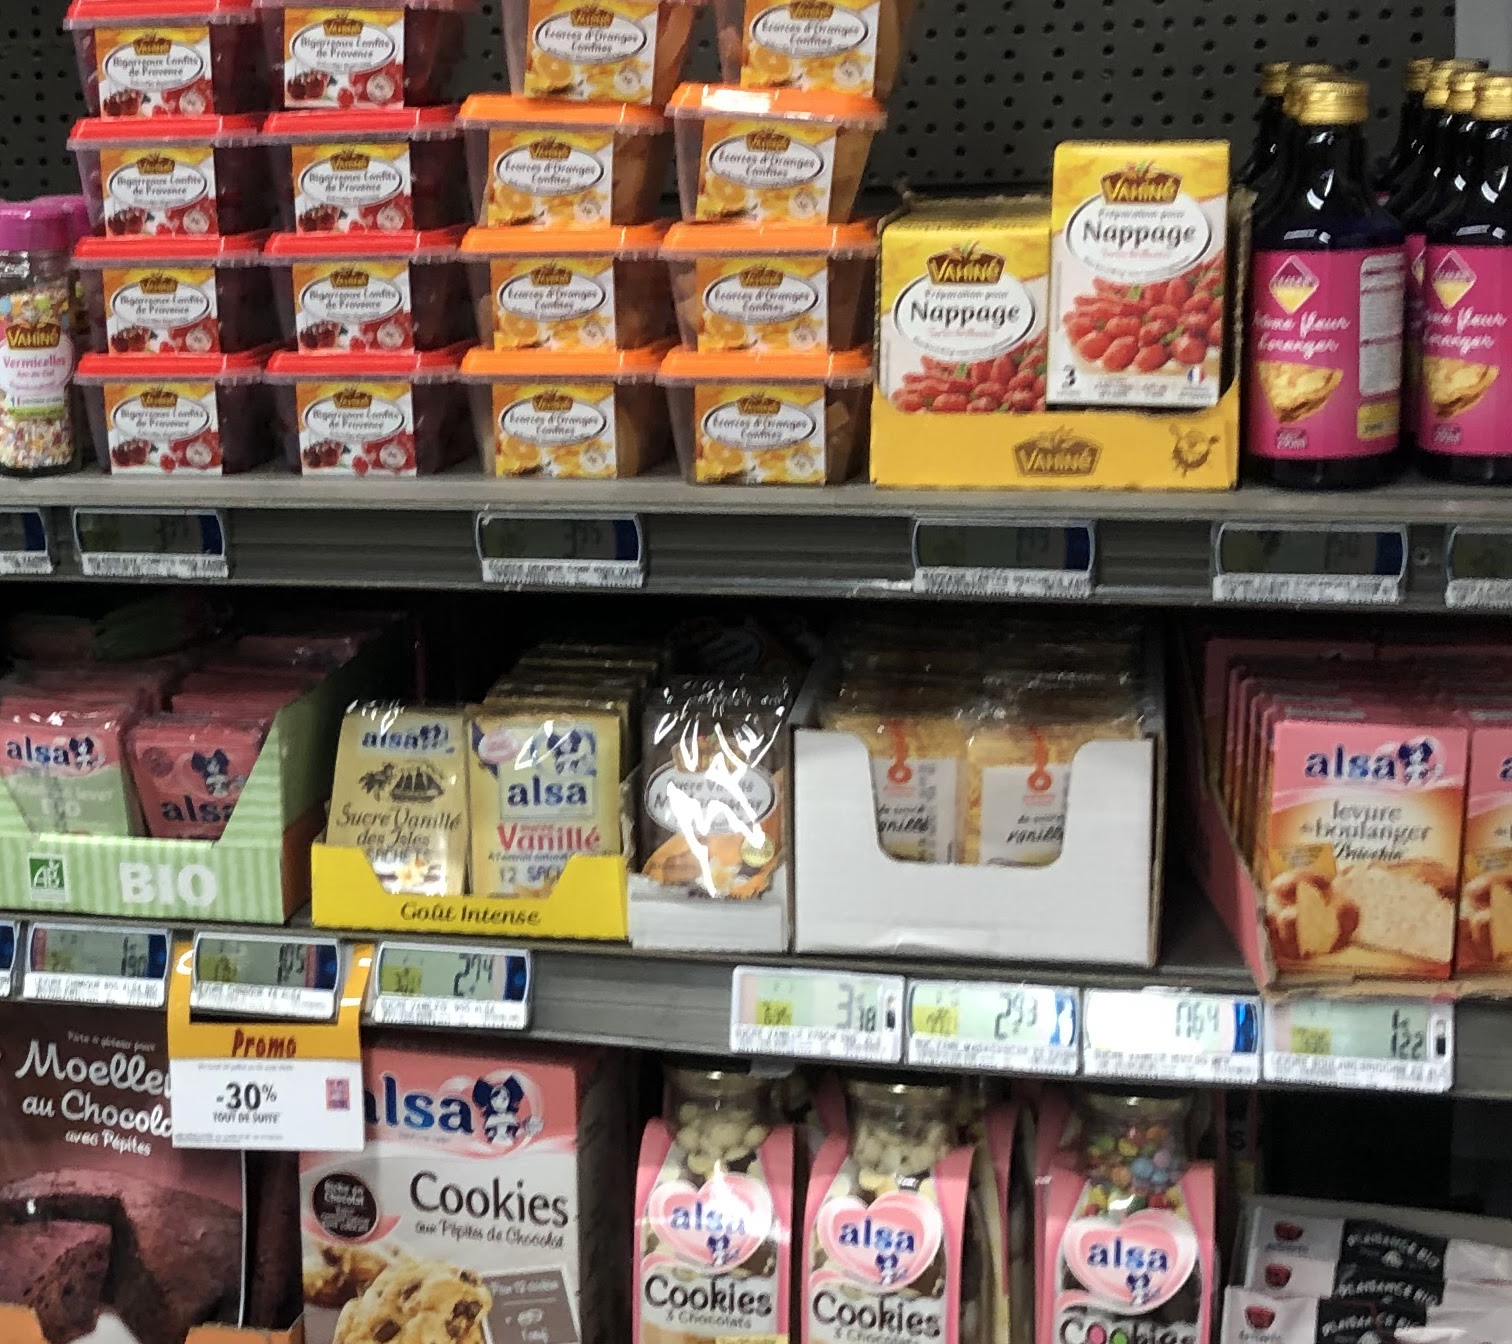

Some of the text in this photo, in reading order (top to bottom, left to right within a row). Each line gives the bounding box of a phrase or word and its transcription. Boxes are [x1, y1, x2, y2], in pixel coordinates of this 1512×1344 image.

[1082, 219, 1197, 253] Nappage
[909, 301, 1021, 330] Nappage
[2, 353, 72, 373] Vermicelles
[1063, 366, 1077, 389] 3
[4, 733, 73, 767] alsa
[1304, 745, 1397, 782] alsa
[506, 776, 589, 809] alsa
[1332, 801, 1402, 827] levure
[495, 822, 601, 855] Vanillé
[118, 861, 217, 907] BIO
[399, 901, 541, 926] Goût Intense
[231, 1030, 297, 1058] Promo
[21, 1095, 55, 1119] au
[215, 1080, 278, 1110] -30%
[64, 1130, 152, 1156] avec Pépites
[409, 1168, 569, 1228] Cookies
[836, 1217, 916, 1256] alsa
[1087, 1238, 1170, 1275] alsa
[643, 1275, 775, 1320] Cookies
[811, 1290, 944, 1340] Cookies
